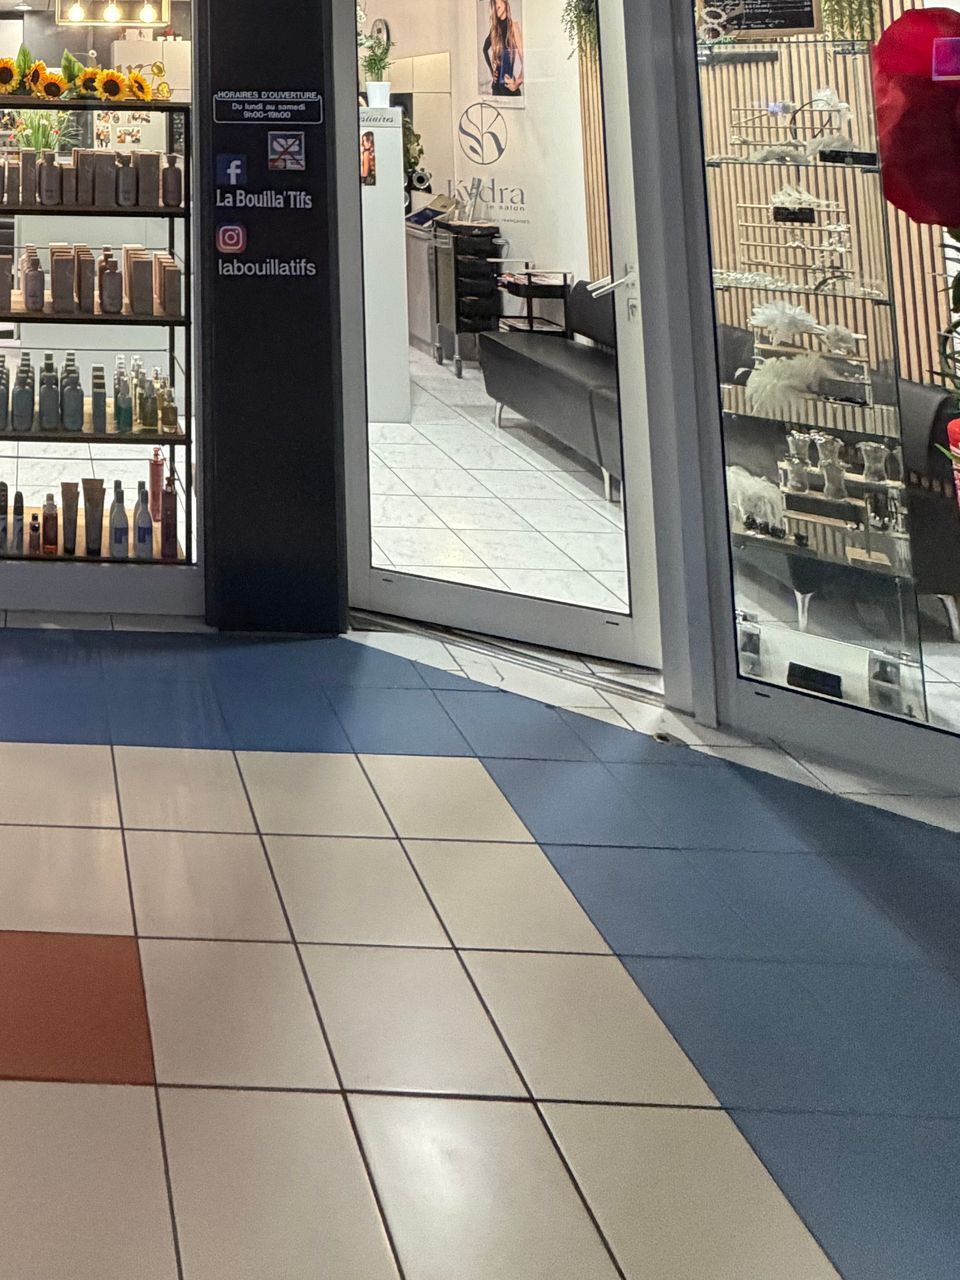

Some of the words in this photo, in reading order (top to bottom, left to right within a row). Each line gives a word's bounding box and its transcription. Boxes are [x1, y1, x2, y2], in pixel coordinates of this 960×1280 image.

[218, 91, 259, 99] HORAIRES
[261, 91, 317, 100] D'OUVERTURE
[231, 102, 243, 110] Du
[277, 103, 306, 111] samedi
[243, 111, 292, 119] 9h00-19h00
[360, 111, 394, 123] stiaires
[215, 189, 233, 207] La
[218, 258, 317, 276] labouillatifs
